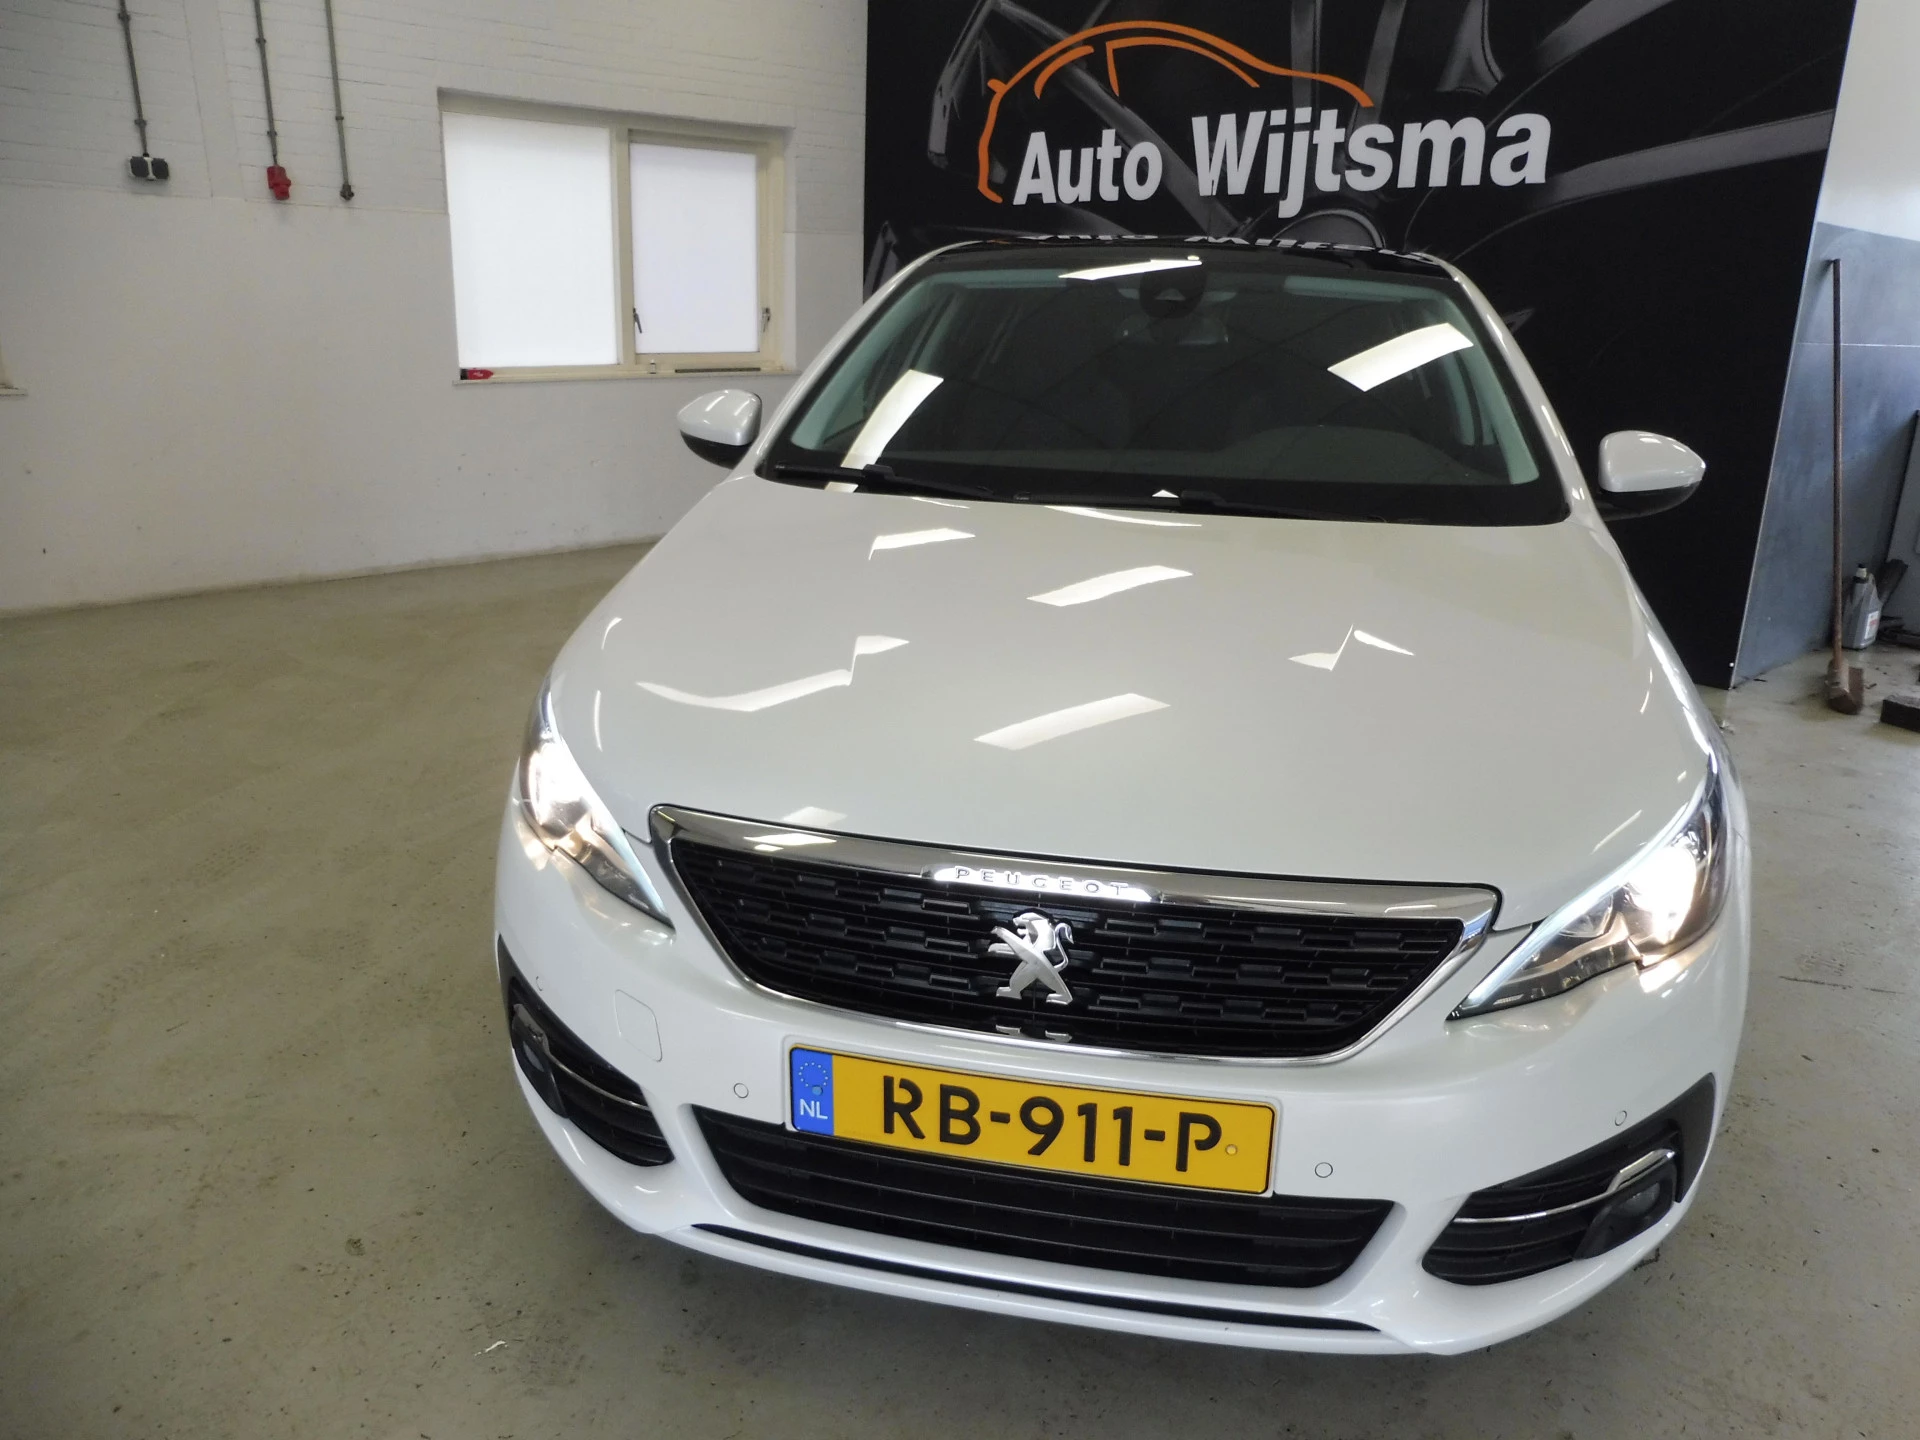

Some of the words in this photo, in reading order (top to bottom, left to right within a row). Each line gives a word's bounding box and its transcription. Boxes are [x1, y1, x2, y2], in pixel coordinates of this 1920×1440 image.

[1012, 129, 1163, 205] Auto
[1191, 107, 1552, 218] Wijtsma
[954, 866, 1129, 896] PEUGEOT
[799, 1098, 829, 1120] NL
[882, 1075, 1222, 1173] RB-911-P
